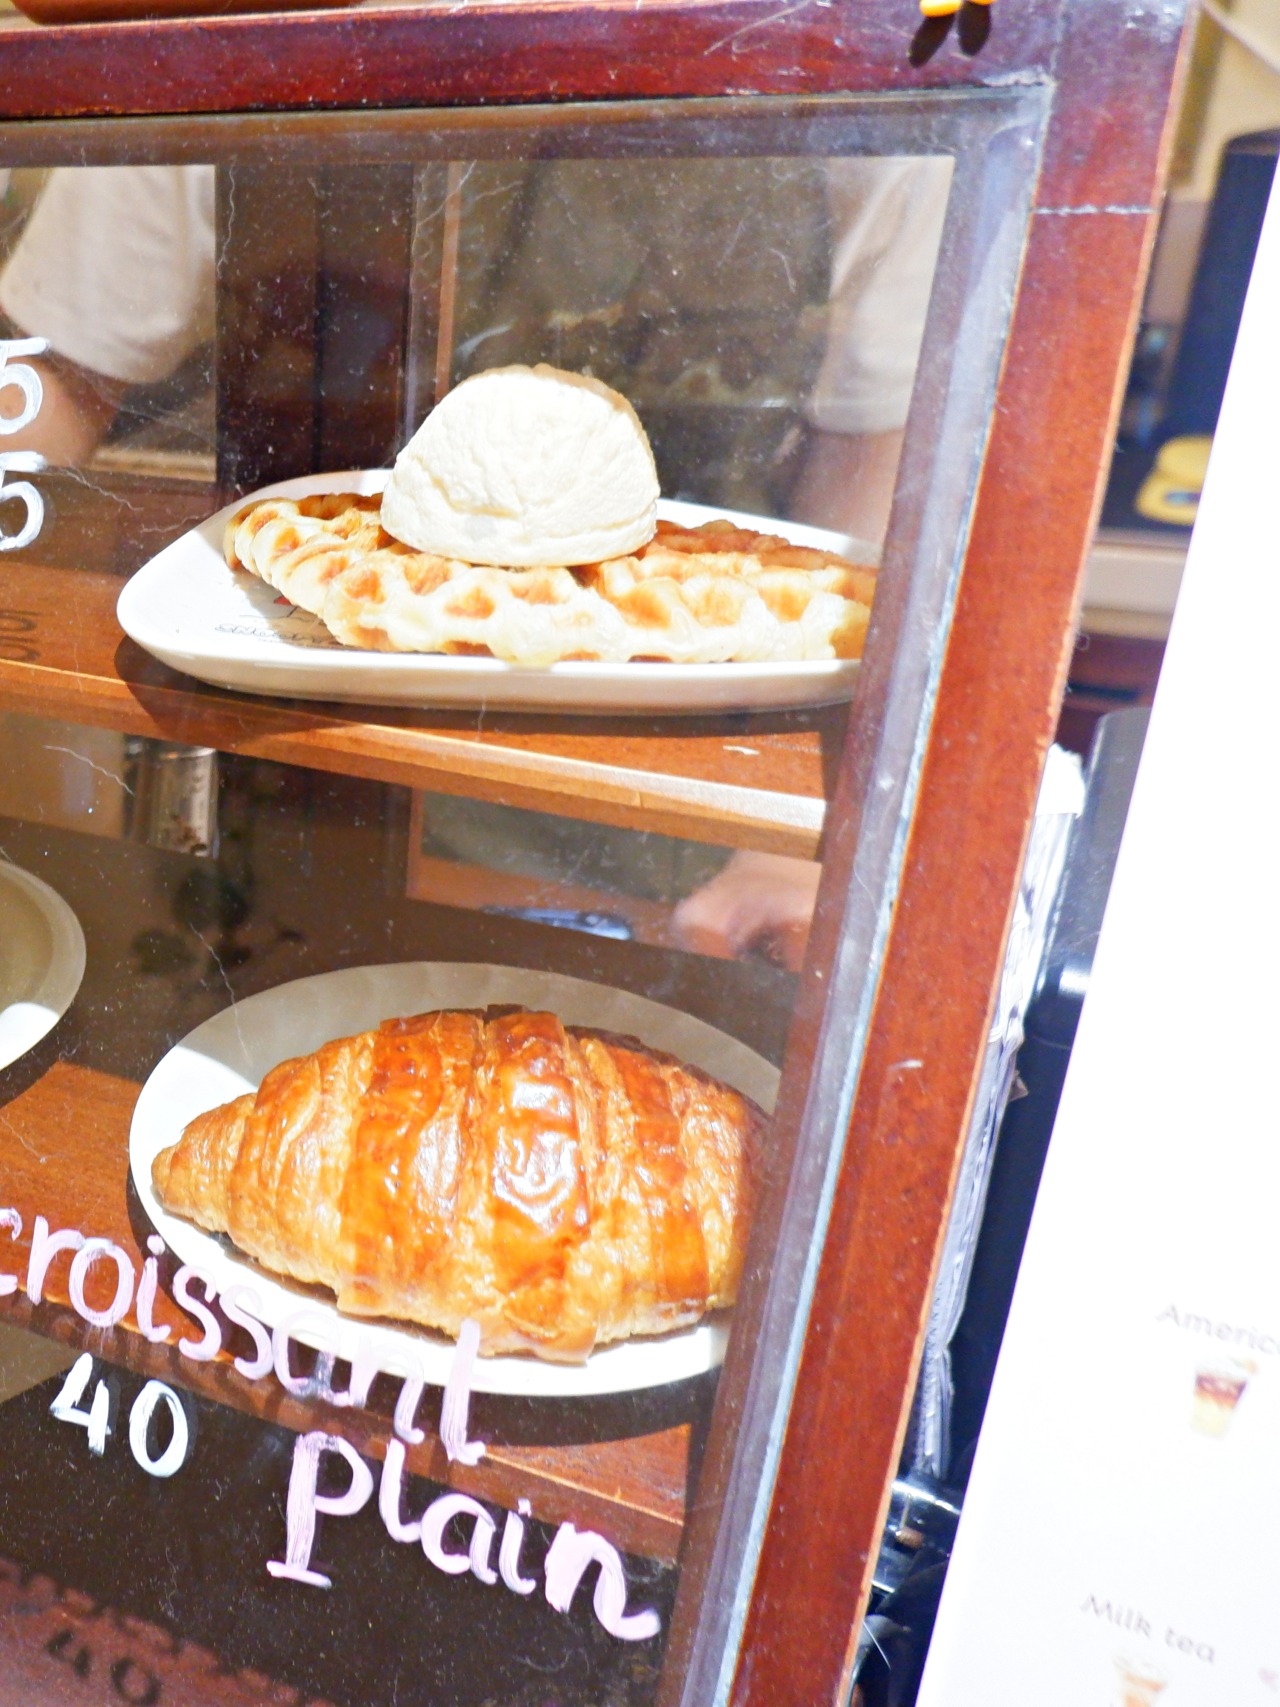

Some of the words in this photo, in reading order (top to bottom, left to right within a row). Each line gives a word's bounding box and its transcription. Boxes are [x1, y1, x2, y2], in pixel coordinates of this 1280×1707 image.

[1154, 1302, 1280, 1357] Americ
[51, 1353, 189, 1478] 40
[1078, 1592, 1152, 1640] Milk
[1164, 1625, 1216, 1665] tea
